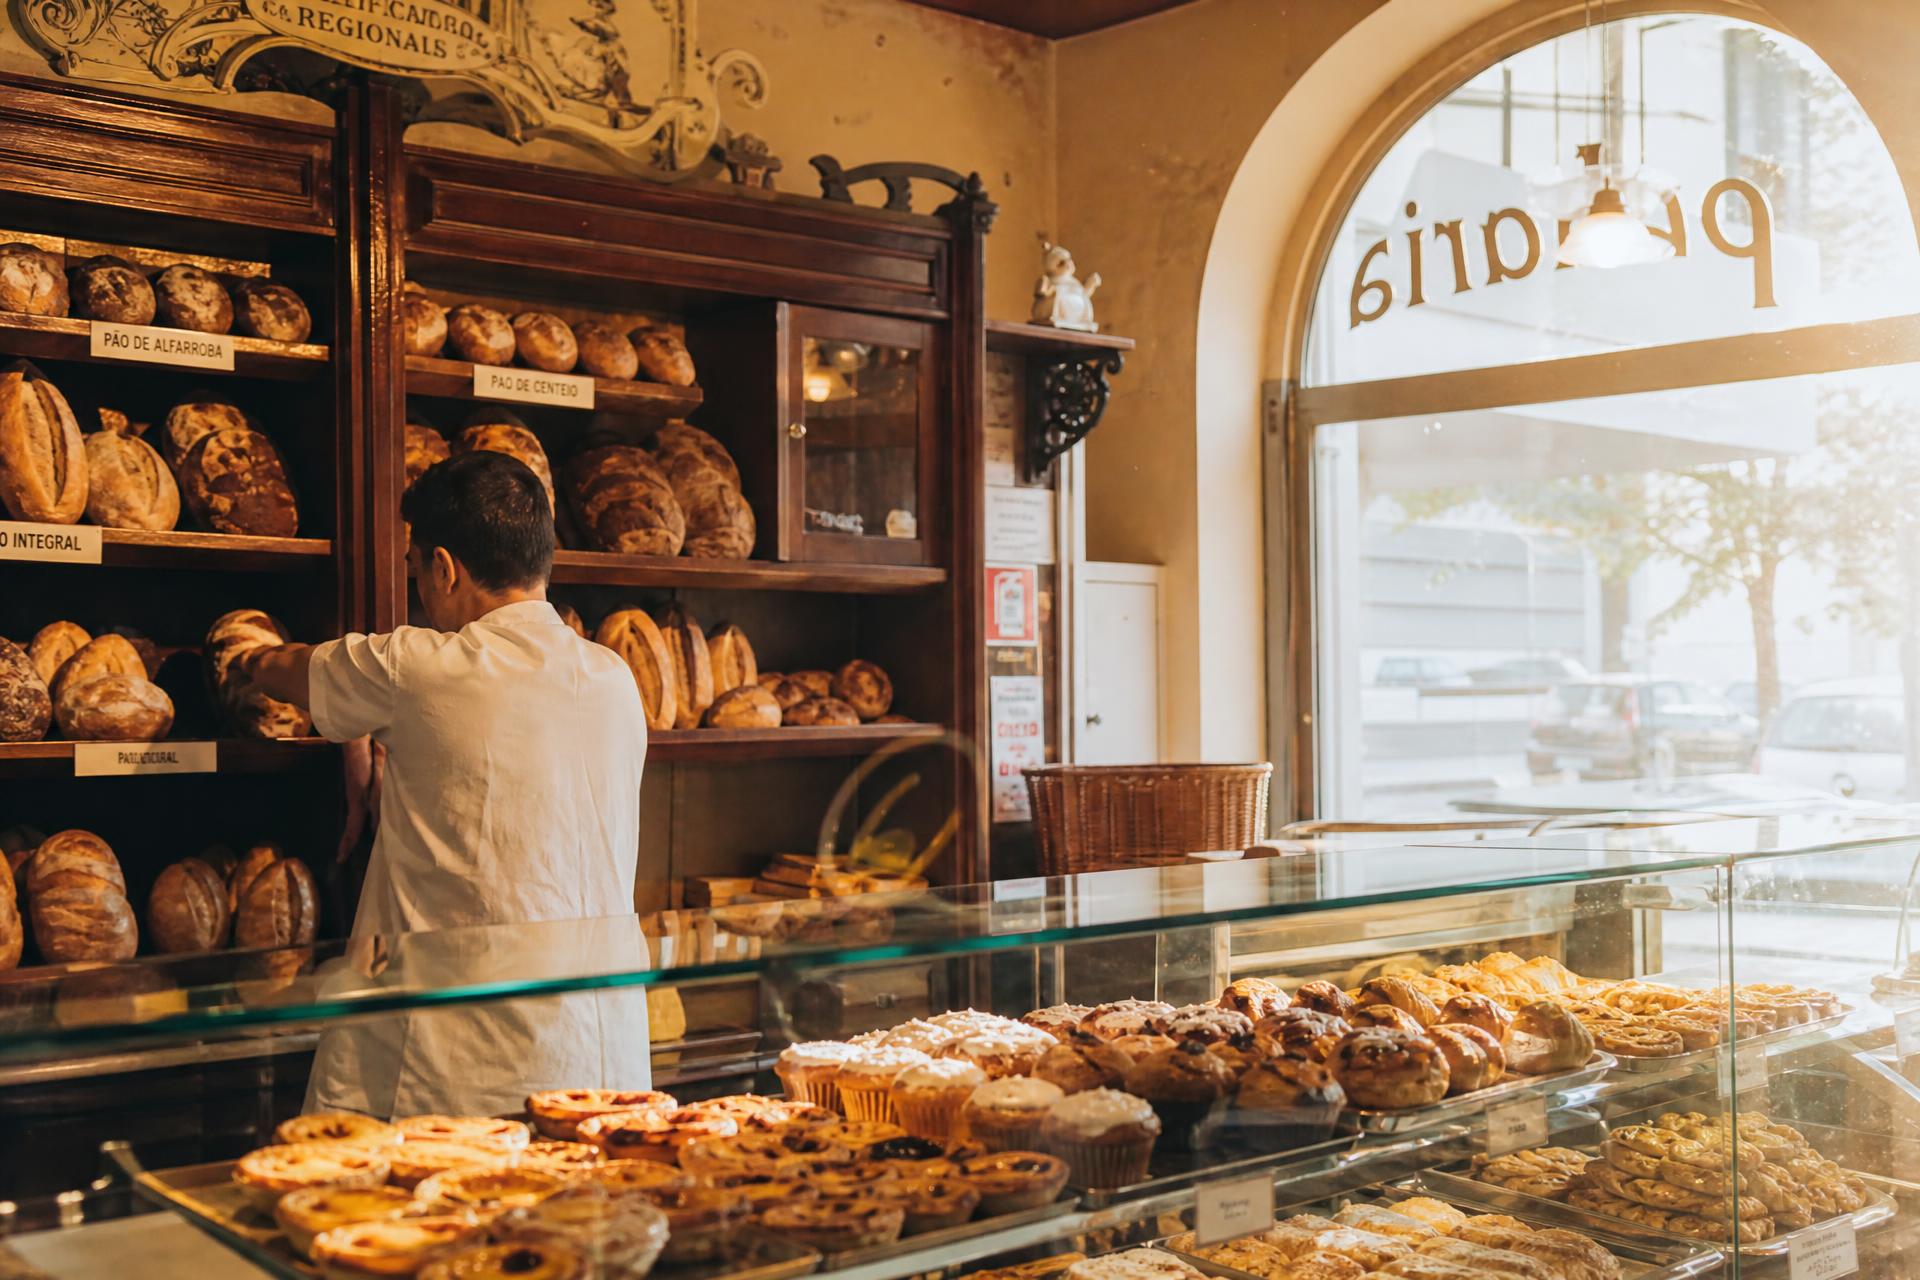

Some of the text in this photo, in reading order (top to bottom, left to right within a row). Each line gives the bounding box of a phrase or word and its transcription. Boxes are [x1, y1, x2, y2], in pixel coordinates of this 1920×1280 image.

[104, 330, 223, 358] PÃO DE ALFARROBA
[516, 378, 529, 392] DE
[13, 532, 82, 551] INTEGRAL
